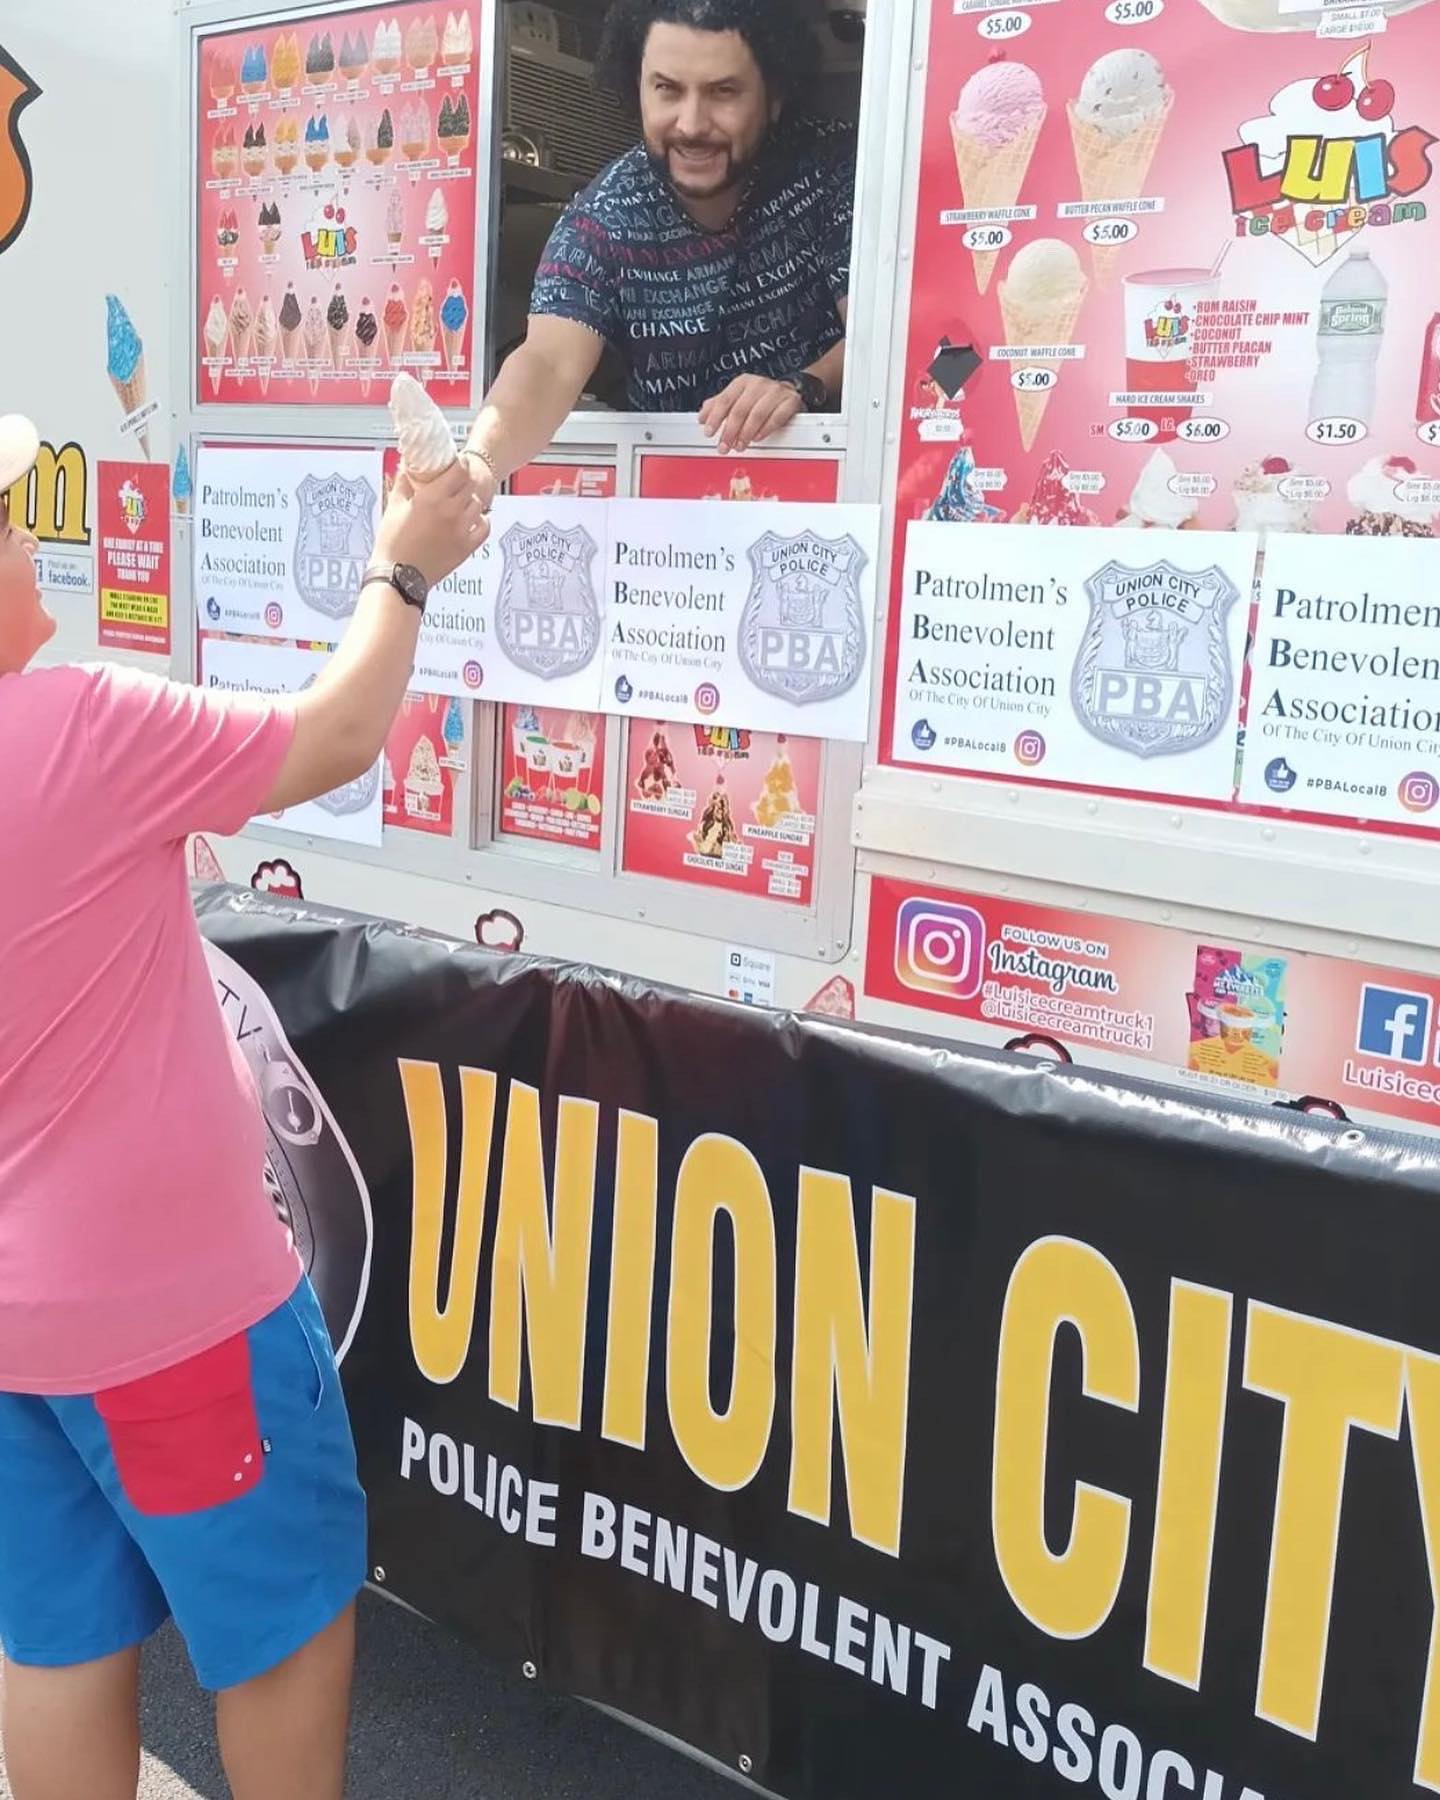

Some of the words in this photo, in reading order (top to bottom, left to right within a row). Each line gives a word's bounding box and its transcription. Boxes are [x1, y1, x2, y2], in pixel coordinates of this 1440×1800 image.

[1114, 0, 1153, 20] $5.00
[986, 16, 1022, 35] $5.00
[945, 210, 987, 222] STRAWBERRY
[988, 209, 1012, 220] WAFFLE
[1013, 208, 1031, 218] CONE
[1065, 204, 1089, 215] BUTTER
[1090, 202, 1111, 214] PECAN
[1111, 201, 1138, 212] WAFFLE
[1139, 200, 1156, 210] CONE
[1236, 204, 1295, 237] ice
[1304, 201, 1426, 232] cream
[970, 231, 1003, 246] $5.00
[1093, 224, 1128, 240] $5.00
[1222, 300, 1257, 312] RAISIN
[1194, 314, 1254, 327] CHOCOLATE
[1255, 313, 1281, 326] CHIP
[1282, 312, 1310, 325] MINT
[1194, 328, 1242, 341] COCONUT
[997, 348, 1028, 357] COCONUT
[1031, 348, 1057, 357] WAFFLE
[1058, 347, 1076, 356] CONE
[1192, 342, 1231, 354] BUTTER
[1232, 341, 1272, 353] PEACAN
[1191, 355, 1260, 368] STRAWBERRY
[1018, 373, 1049, 386] $5.00
[1190, 369, 1215, 382] OREO
[1116, 395, 1136, 404] HARD
[1137, 395, 1149, 404] ICE
[1150, 395, 1176, 404] CREAM
[1176, 395, 1205, 404] SHAKES
[1116, 422, 1150, 436] $5.00
[1186, 423, 1221, 437] $6.00
[1317, 423, 1357, 438] $1.50
[312, 481, 338, 501] UNION
[340, 483, 358, 502] CITY
[318, 498, 352, 512] POLICE
[201, 518, 283, 542] Benevolent
[519, 532, 549, 551] UNION
[550, 533, 573, 551] CITY
[107, 551, 137, 569] PLEASE
[138, 553, 159, 570] WAIT
[525, 548, 566, 564] POLICE
[771, 542, 809, 564] UNION
[811, 542, 838, 564] CITY
[200, 552, 286, 577] Association
[308, 558, 361, 590] PBA
[779, 558, 829, 577] POLICE
[436, 571, 483, 596] olent
[1115, 573, 1163, 598] UNION
[1168, 574, 1201, 599] CITY
[613, 580, 725, 612] Benevolent
[1126, 595, 1189, 613] POLICE
[423, 606, 486, 633] ociation
[514, 613, 580, 650] PBA
[611, 620, 726, 652] Association
[912, 614, 1055, 651] Benevolent
[640, 651, 658, 665] City
[675, 655, 702, 668] Union
[703, 657, 723, 672] City
[760, 630, 841, 674] PBA
[908, 658, 1056, 697] Association
[909, 689, 923, 701] Of
[926, 689, 946, 704] The
[948, 692, 970, 710] City
[972, 694, 988, 708] Of
[991, 697, 1024, 712] Union
[1027, 700, 1052, 718] City
[1097, 674, 1201, 722] PBA
[1261, 688, 1440, 732] Associatio
[1262, 723, 1282, 737] Of
[1284, 725, 1309, 742] The
[1313, 728, 1340, 747] City
[1345, 731, 1364, 746] Of
[1369, 734, 1411, 752] Union
[1416, 739, 1440, 758] Cit
[1306, 777, 1388, 797] #PBALocal8
[633, 802, 667, 813] STRAWBERRY
[667, 807, 689, 817] SUNDAE
[747, 827, 779, 839] PINEAPPLE
[780, 832, 803, 842] SUNDAE
[725, 862, 744, 873] SUNDAE
[1004, 927, 1062, 948] FOLLOW
[1064, 939, 1081, 951] US
[1086, 943, 1106, 956] ON
[989, 943, 1117, 993] Instagram
[983, 982, 1153, 1031] #Luisicecreamtruck1
[397, 1057, 917, 1559] UNION
[400, 1417, 560, 1547] POLICE
[581, 1491, 951, 1711] BENEVOLENT
[966, 1663, 1265, 1800] ASSOC
